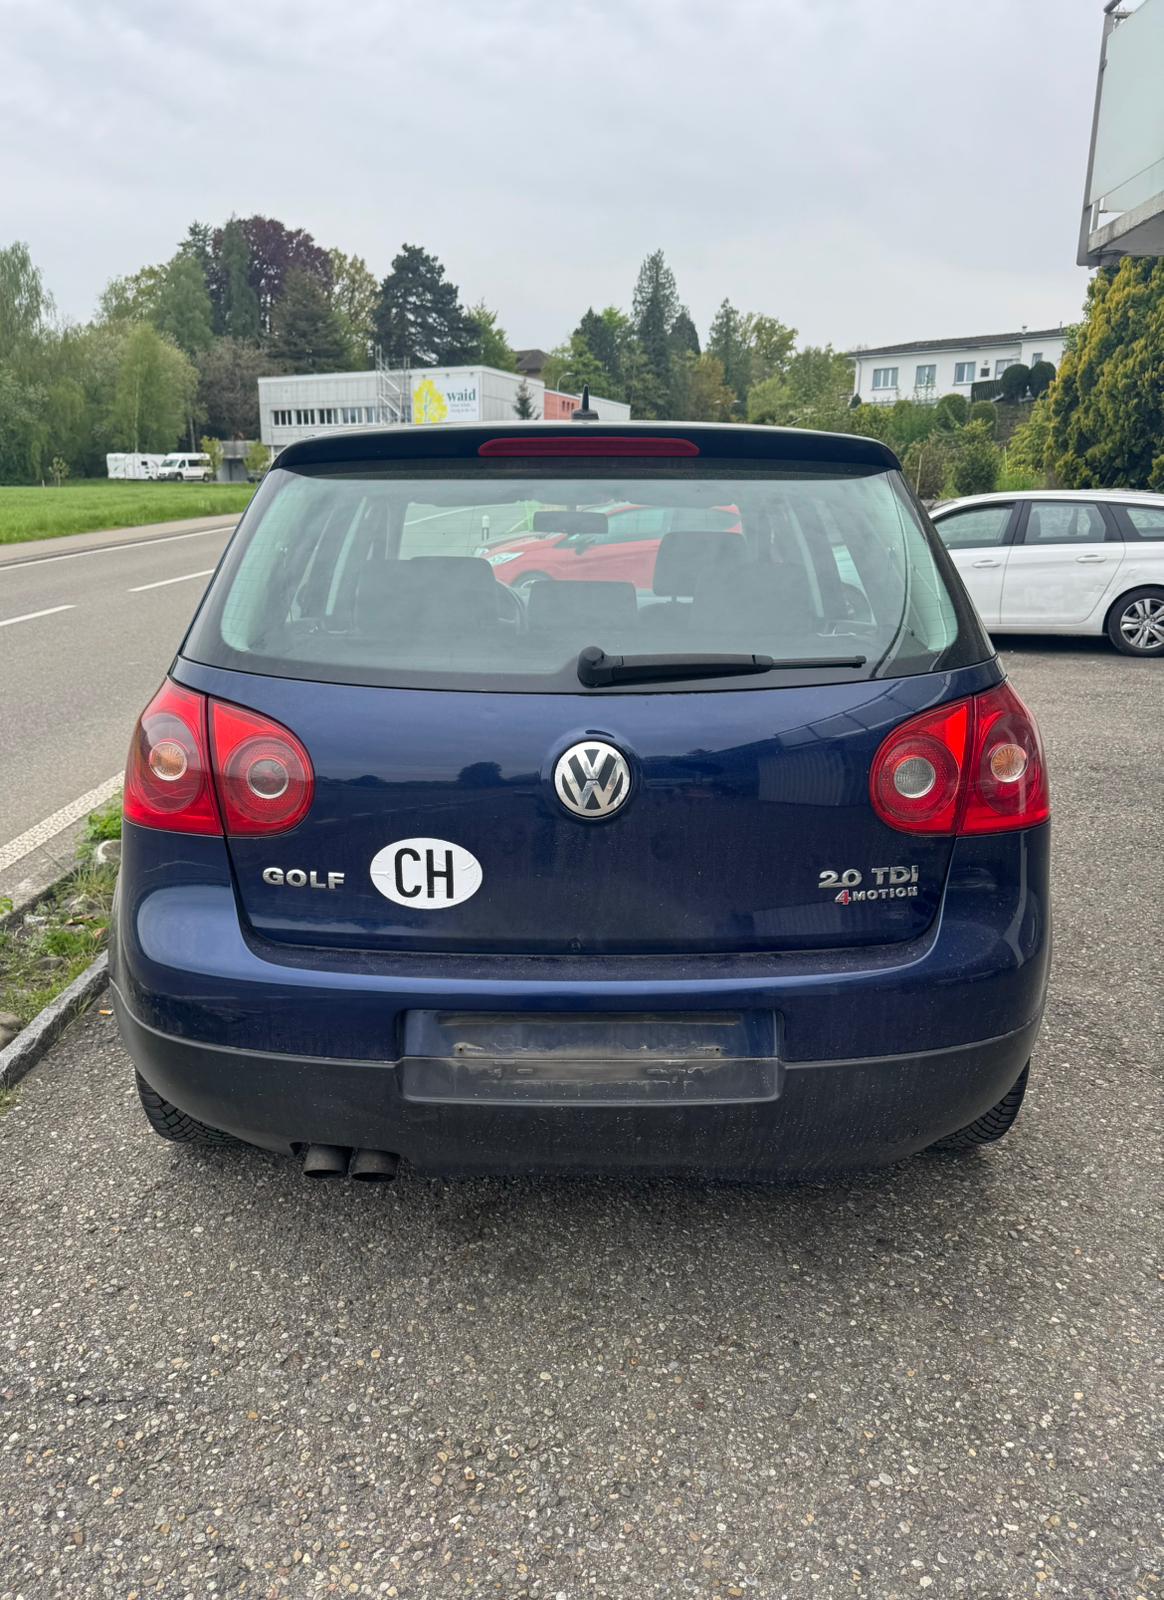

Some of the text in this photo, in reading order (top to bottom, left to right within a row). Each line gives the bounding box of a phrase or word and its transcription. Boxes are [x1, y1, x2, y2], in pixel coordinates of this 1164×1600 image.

[447, 388, 476, 402] waid
[262, 867, 345, 889] GOLF
[394, 848, 454, 899] CH
[835, 886, 918, 905] 4MOTION
